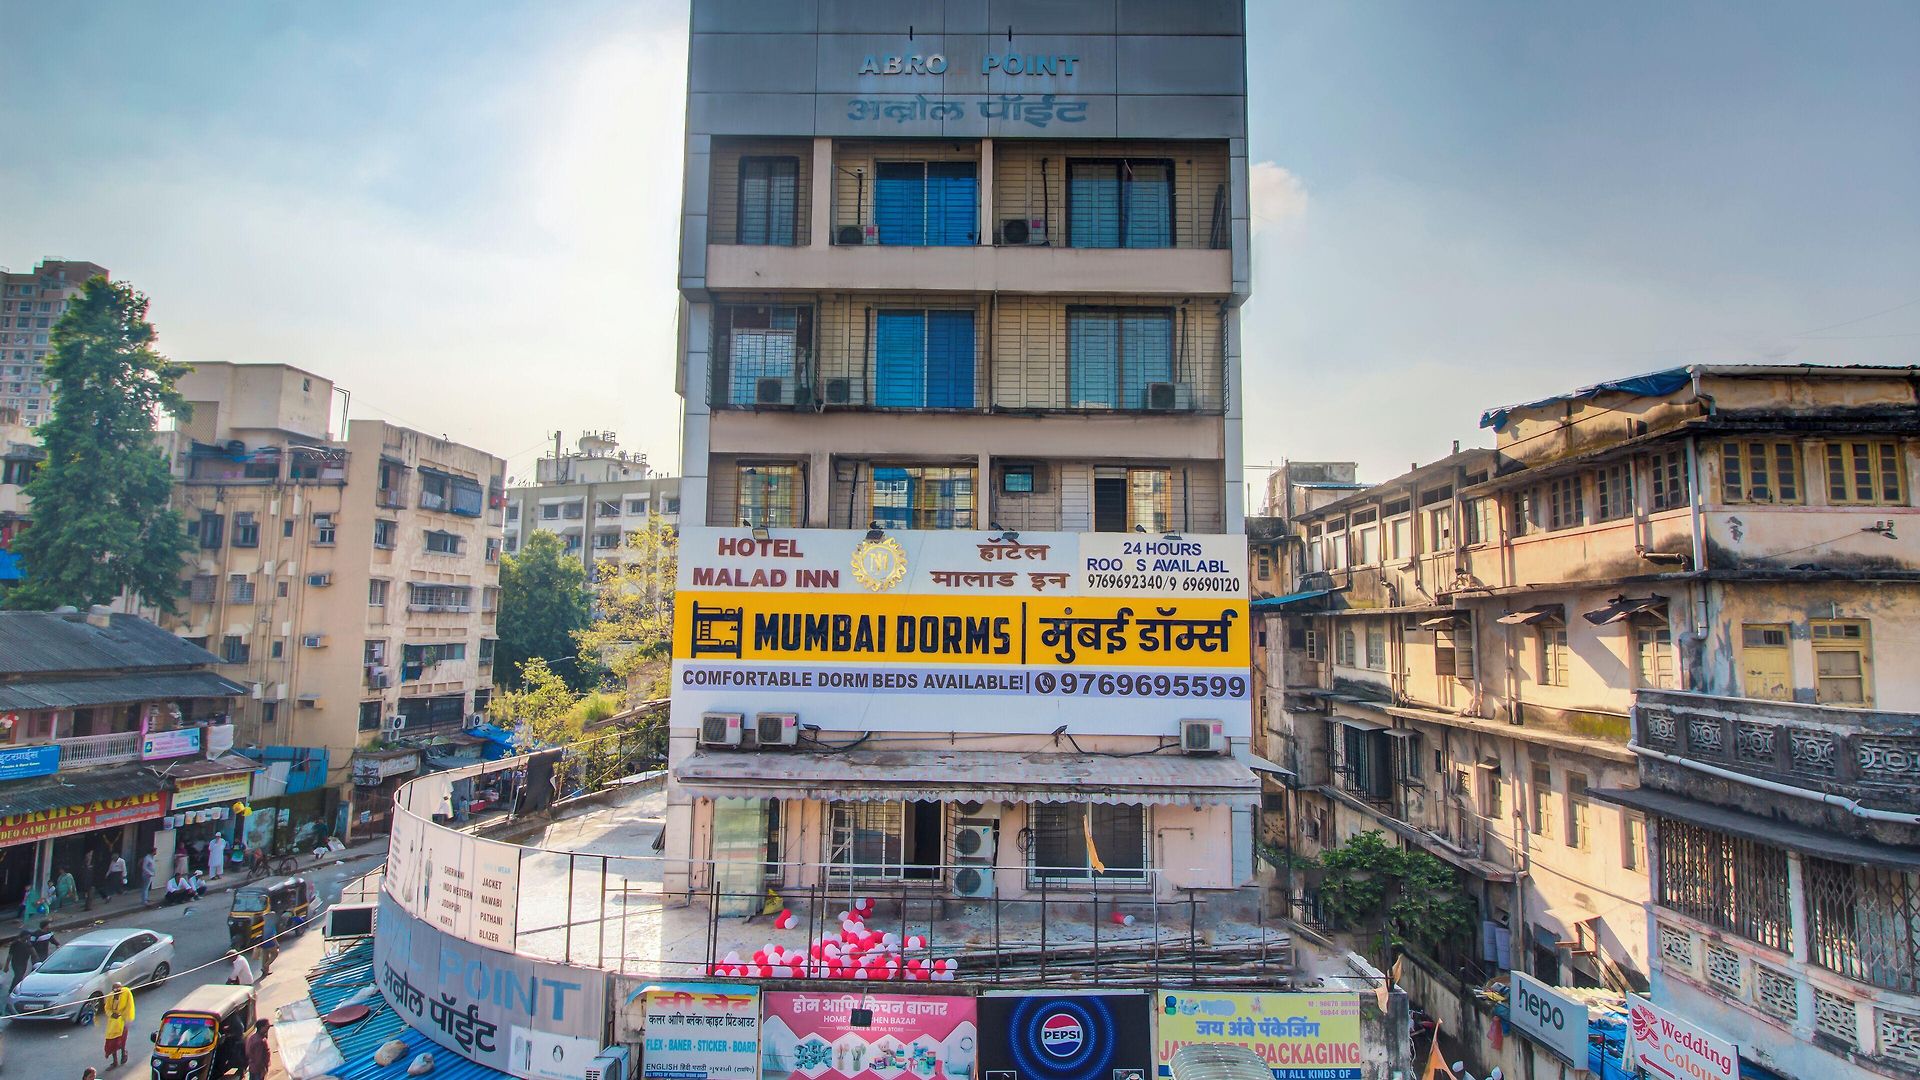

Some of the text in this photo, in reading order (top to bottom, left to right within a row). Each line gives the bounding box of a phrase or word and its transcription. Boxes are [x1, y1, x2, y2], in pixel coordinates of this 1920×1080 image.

[982, 53, 1079, 76] POINT
[718, 538, 804, 558] HOTEL
[976, 537, 1051, 562] हॉटेल
[1123, 542, 1202, 556] 24 HOURS
[1152, 559, 1230, 573] AVAILABL
[692, 567, 839, 588] MALAD INN
[929, 571, 1071, 592] मालाड इन
[1088, 574, 1240, 592] 9769692340/969690120
[754, 613, 1010, 655] MUMBAI DORMS
[1039, 607, 1239, 664] मुंबई डॉर्म्स
[683, 669, 1024, 690] COMFORTABLE DORM BEDS AVAILABLE!
[1060, 673, 1246, 698] 9769695599
[0, 791, 160, 827] UKHSAGAR
[23, 826, 47, 836] GAME
[50, 816, 91, 832] PARLOUR
[482, 878, 502, 890] JACKET
[481, 895, 502, 908] NAWABI
[480, 912, 503, 926] PATHANI
[479, 929, 499, 943] BLAZER
[383, 960, 425, 1018] अब्रोल
[438, 950, 581, 1021] POINT
[793, 995, 820, 1013] होम
[823, 995, 860, 1013] आणि
[906, 1001, 949, 1016] बाजार
[1519, 979, 1565, 1031] hepo
[890, 1017, 916, 1025] BAZAR
[1196, 1020, 1225, 1036] जय
[1228, 1016, 1256, 1037] अंबे
[1044, 1030, 1081, 1040] PEPSI
[646, 1039, 757, 1053] FLEX BANER STICKER BOARD
[1255, 1043, 1360, 1065] PACKAGING
[1660, 1018, 1731, 1076] Wedding
[646, 1063, 678, 1071] ENGLISH
[1276, 1070, 1351, 1079] IN ALL KINDS OF
